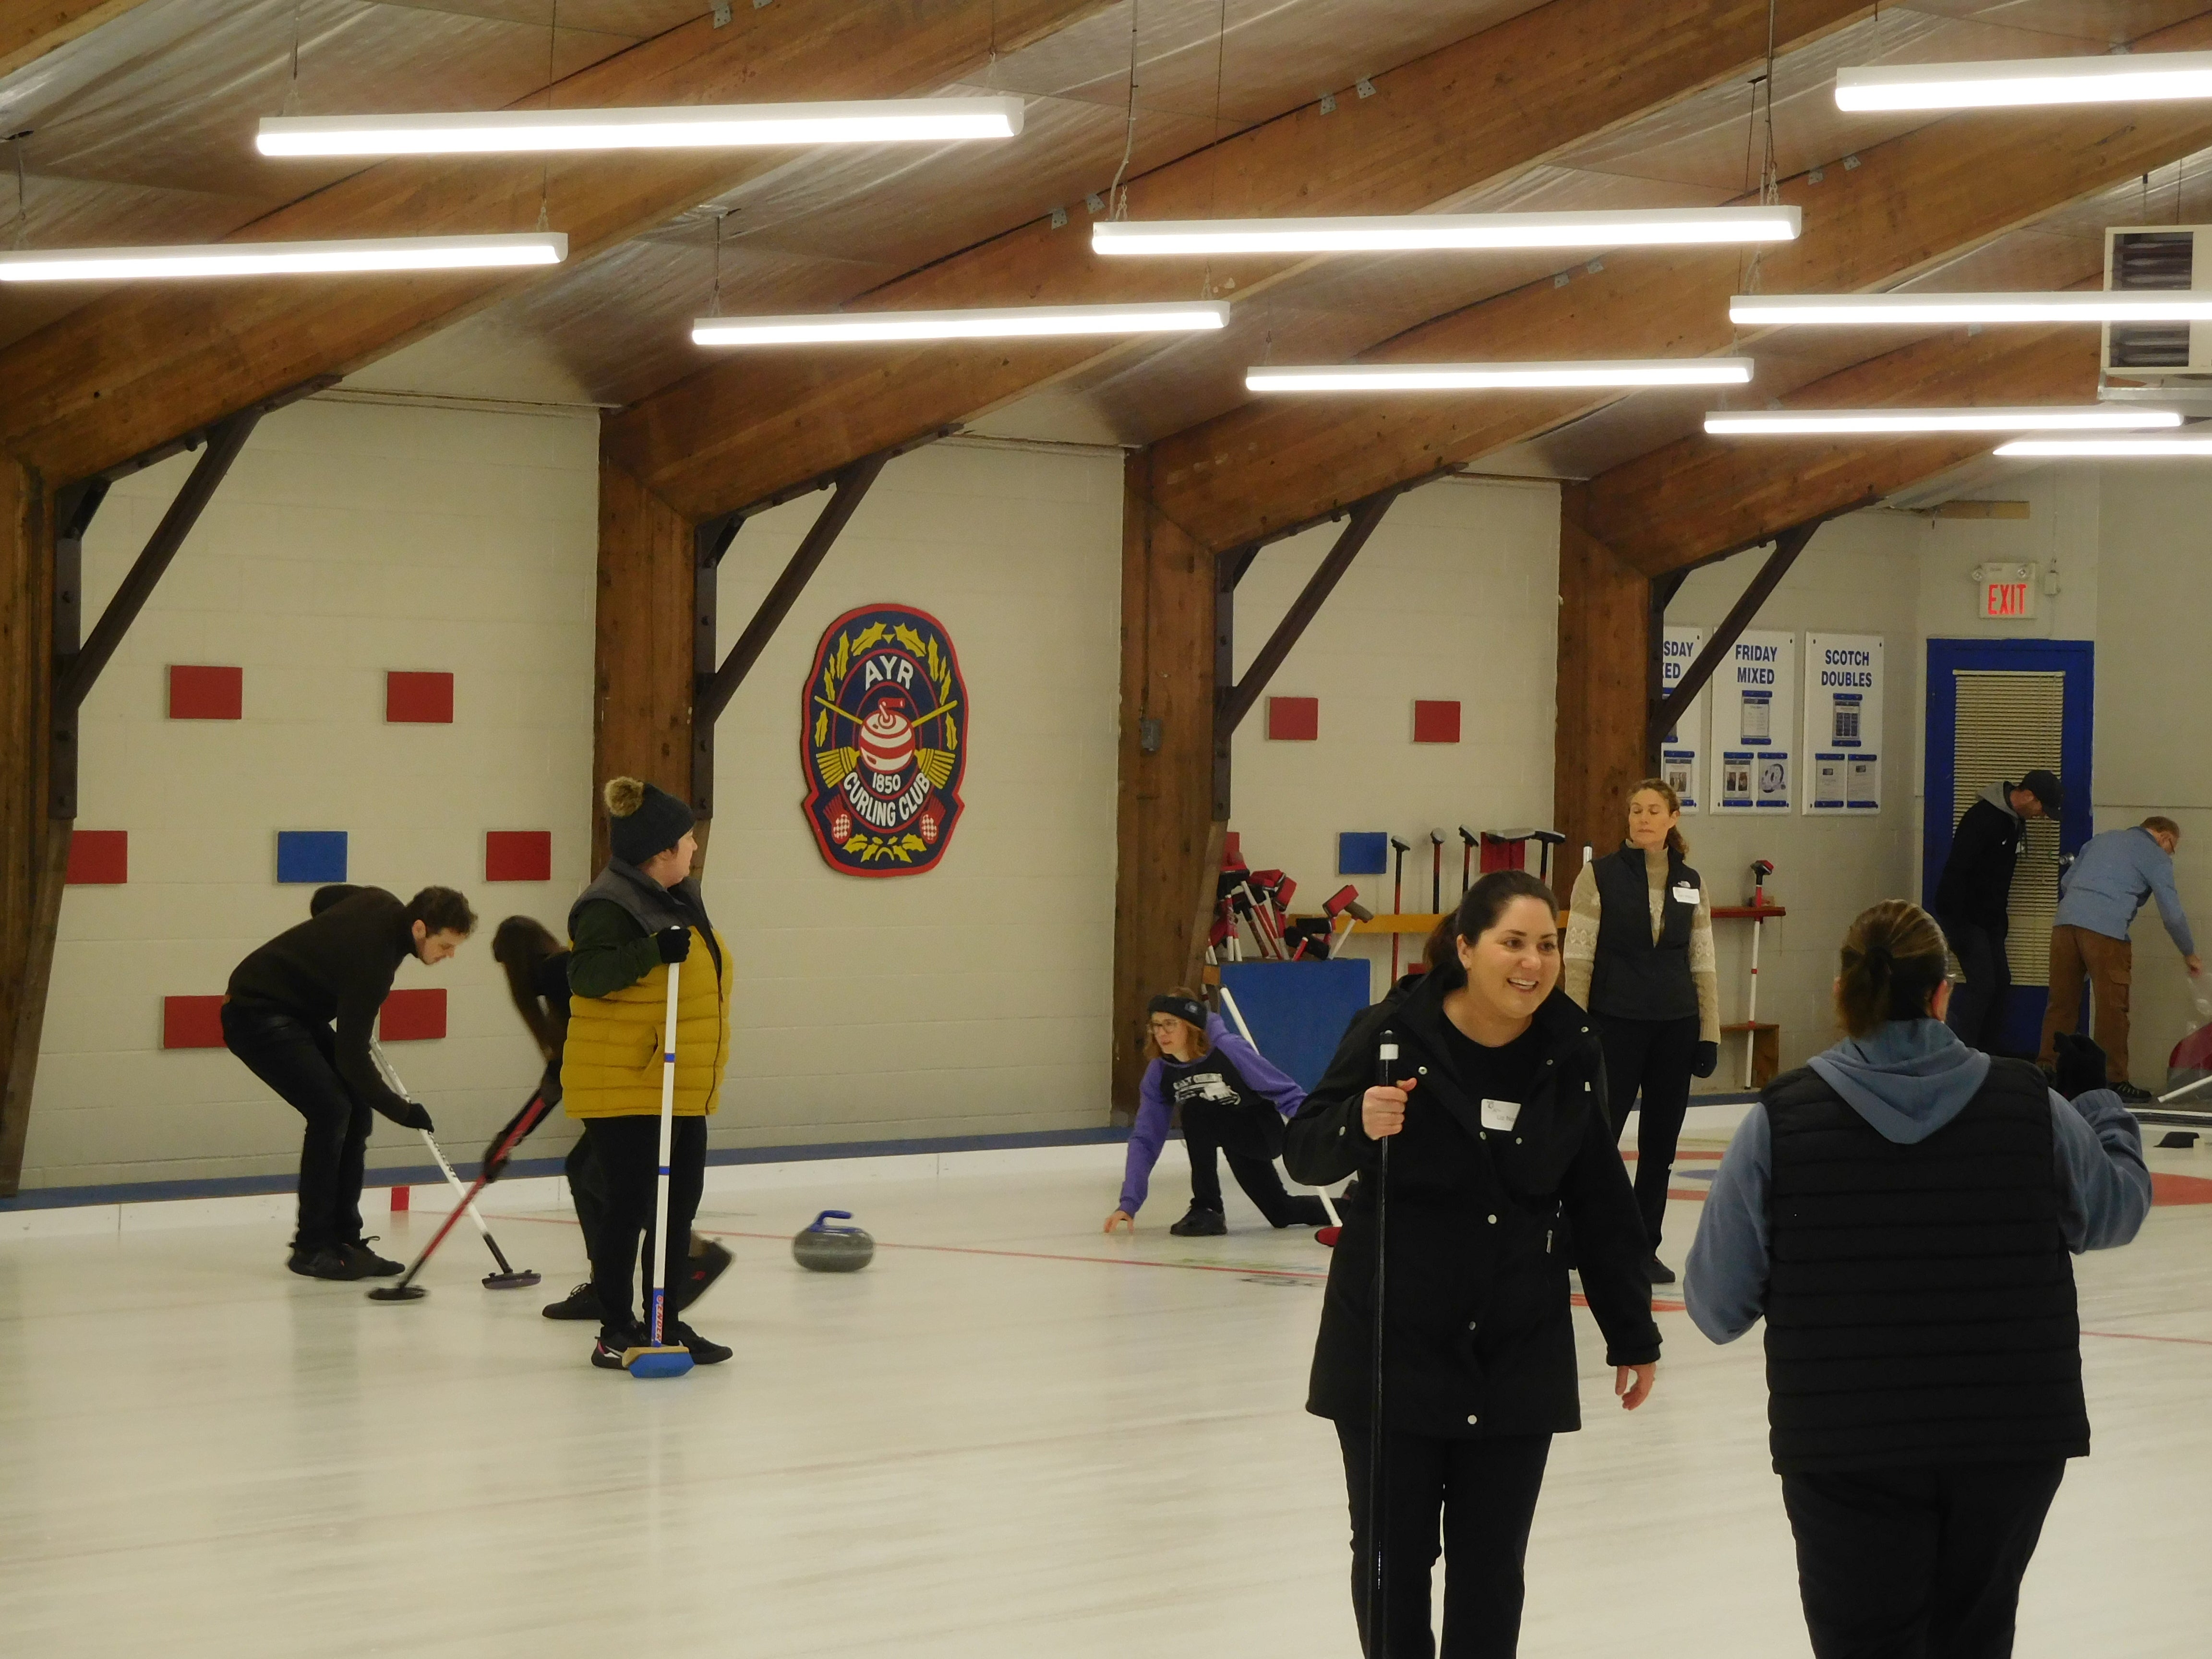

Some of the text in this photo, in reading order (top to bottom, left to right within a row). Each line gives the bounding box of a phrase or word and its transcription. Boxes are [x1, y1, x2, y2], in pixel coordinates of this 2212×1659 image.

[1987, 583, 2027, 615] EXIT
[1735, 644, 1777, 662] FRIDAY
[1825, 649, 1869, 666] SCOTCH
[865, 655, 914, 691] AYR
[1737, 667, 1775, 684] MIXED
[1821, 671, 1872, 687] DOUBLES
[872, 772, 901, 793] 1850
[844, 772, 930, 827] CURLING CLUB
